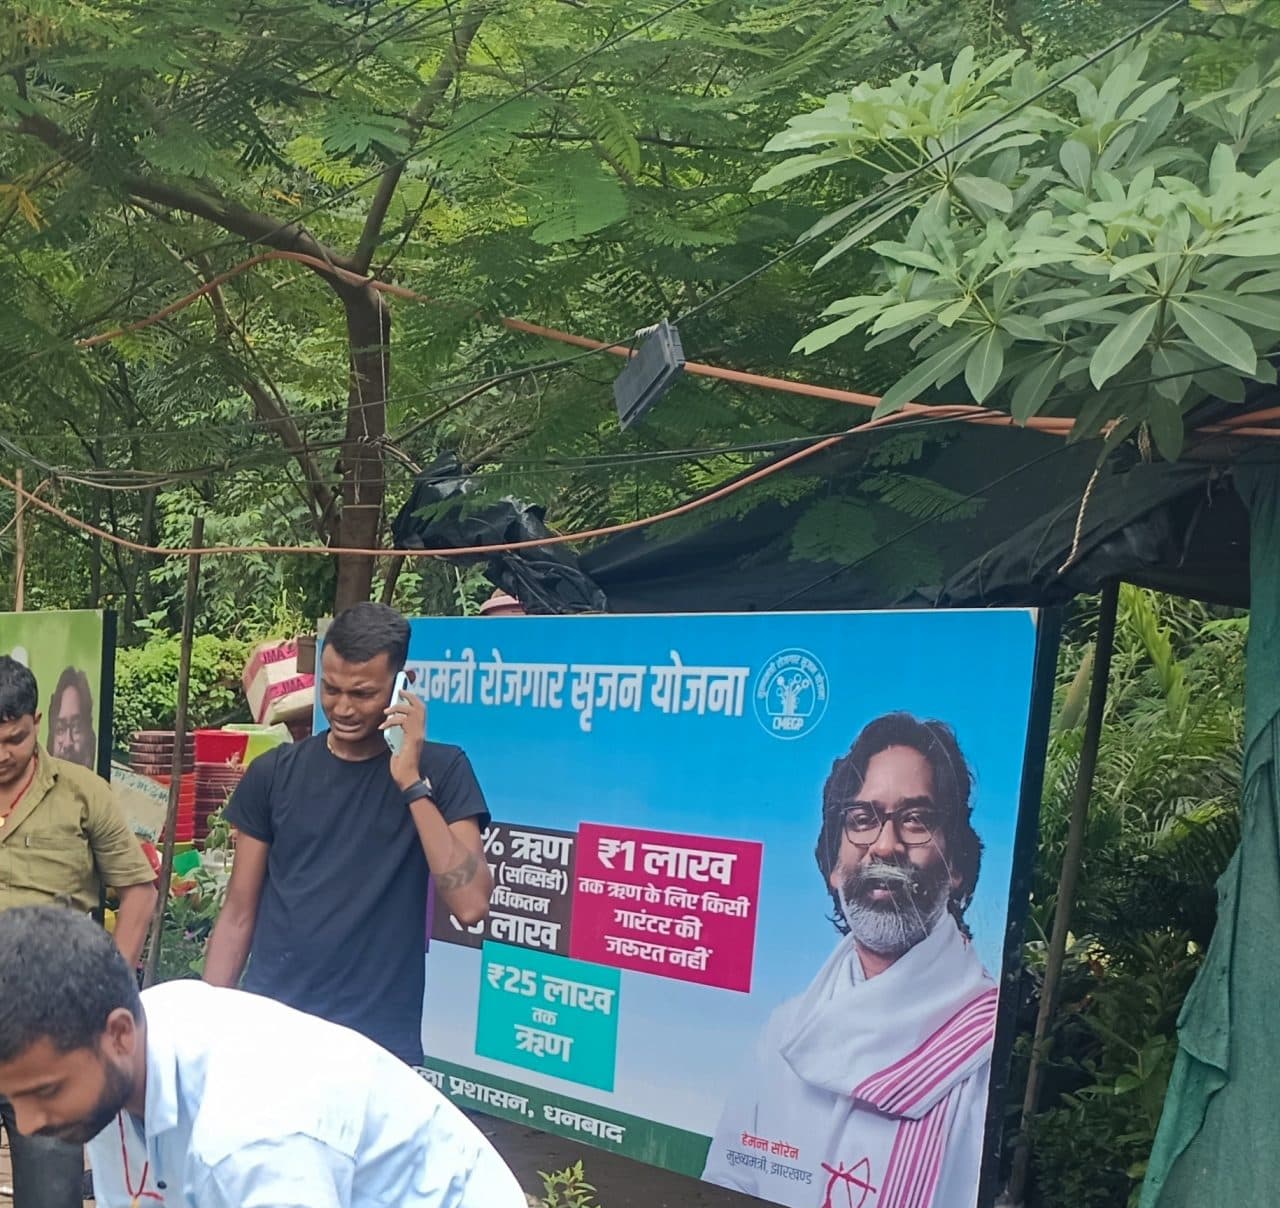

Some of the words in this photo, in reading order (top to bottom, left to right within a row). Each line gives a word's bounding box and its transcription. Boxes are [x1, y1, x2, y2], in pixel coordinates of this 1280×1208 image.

[479, 647, 568, 709] रोजगार
[570, 663, 647, 732] सृजन
[650, 649, 750, 717] योजना
[509, 830, 573, 866] ऋण
[598, 838, 636, 872] ₹1
[641, 843, 737, 885] लाख
[499, 861, 568, 895] (सब्सिडी)
[490, 885, 551, 914] धिकतम
[578, 877, 605, 895] तक
[607, 881, 642, 901] ऋण
[644, 883, 662, 904] के
[663, 886, 700, 910] लिए
[701, 892, 751, 918] किसी
[489, 910, 561, 951] लाख
[614, 908, 672, 935] गारंटर
[674, 914, 703, 941] की
[668, 946, 714, 971] नहीं
[487, 962, 537, 997] ₹25
[541, 974, 616, 1015] लाख
[531, 1007, 559, 1026] तक
[514, 1023, 574, 1063] ऋण
[449, 1076, 535, 1118] प्रशासन,
[543, 1105, 626, 1144] धनबाद
[741, 1131, 769, 1152] हेमन्त
[771, 1140, 800, 1160] सोरेन
[726, 1149, 768, 1175] मुख्यमंत्री,
[770, 1161, 813, 1185] झारखण्ड
